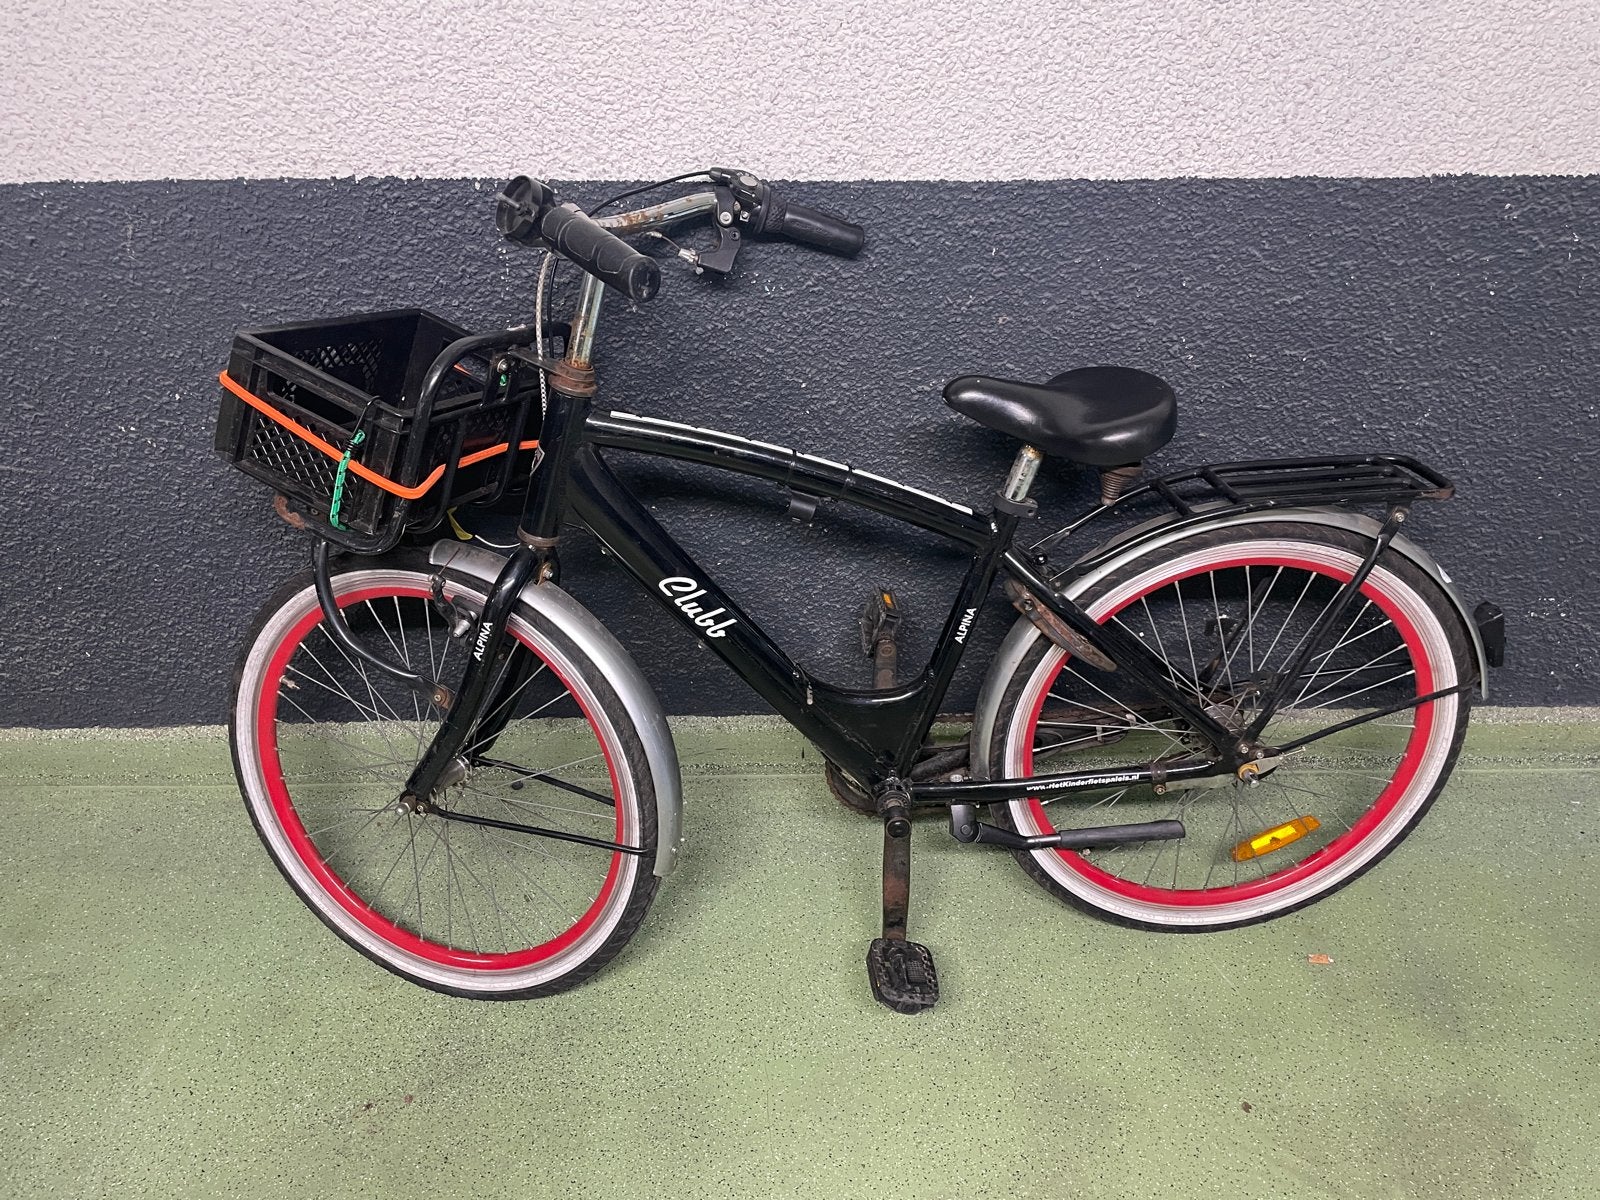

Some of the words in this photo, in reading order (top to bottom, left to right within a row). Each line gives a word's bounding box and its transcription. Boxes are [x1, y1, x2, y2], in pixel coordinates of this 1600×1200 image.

[658, 576, 738, 638] Clubb
[954, 608, 977, 644] ALPINA
[473, 622, 493, 661] ALPINA
